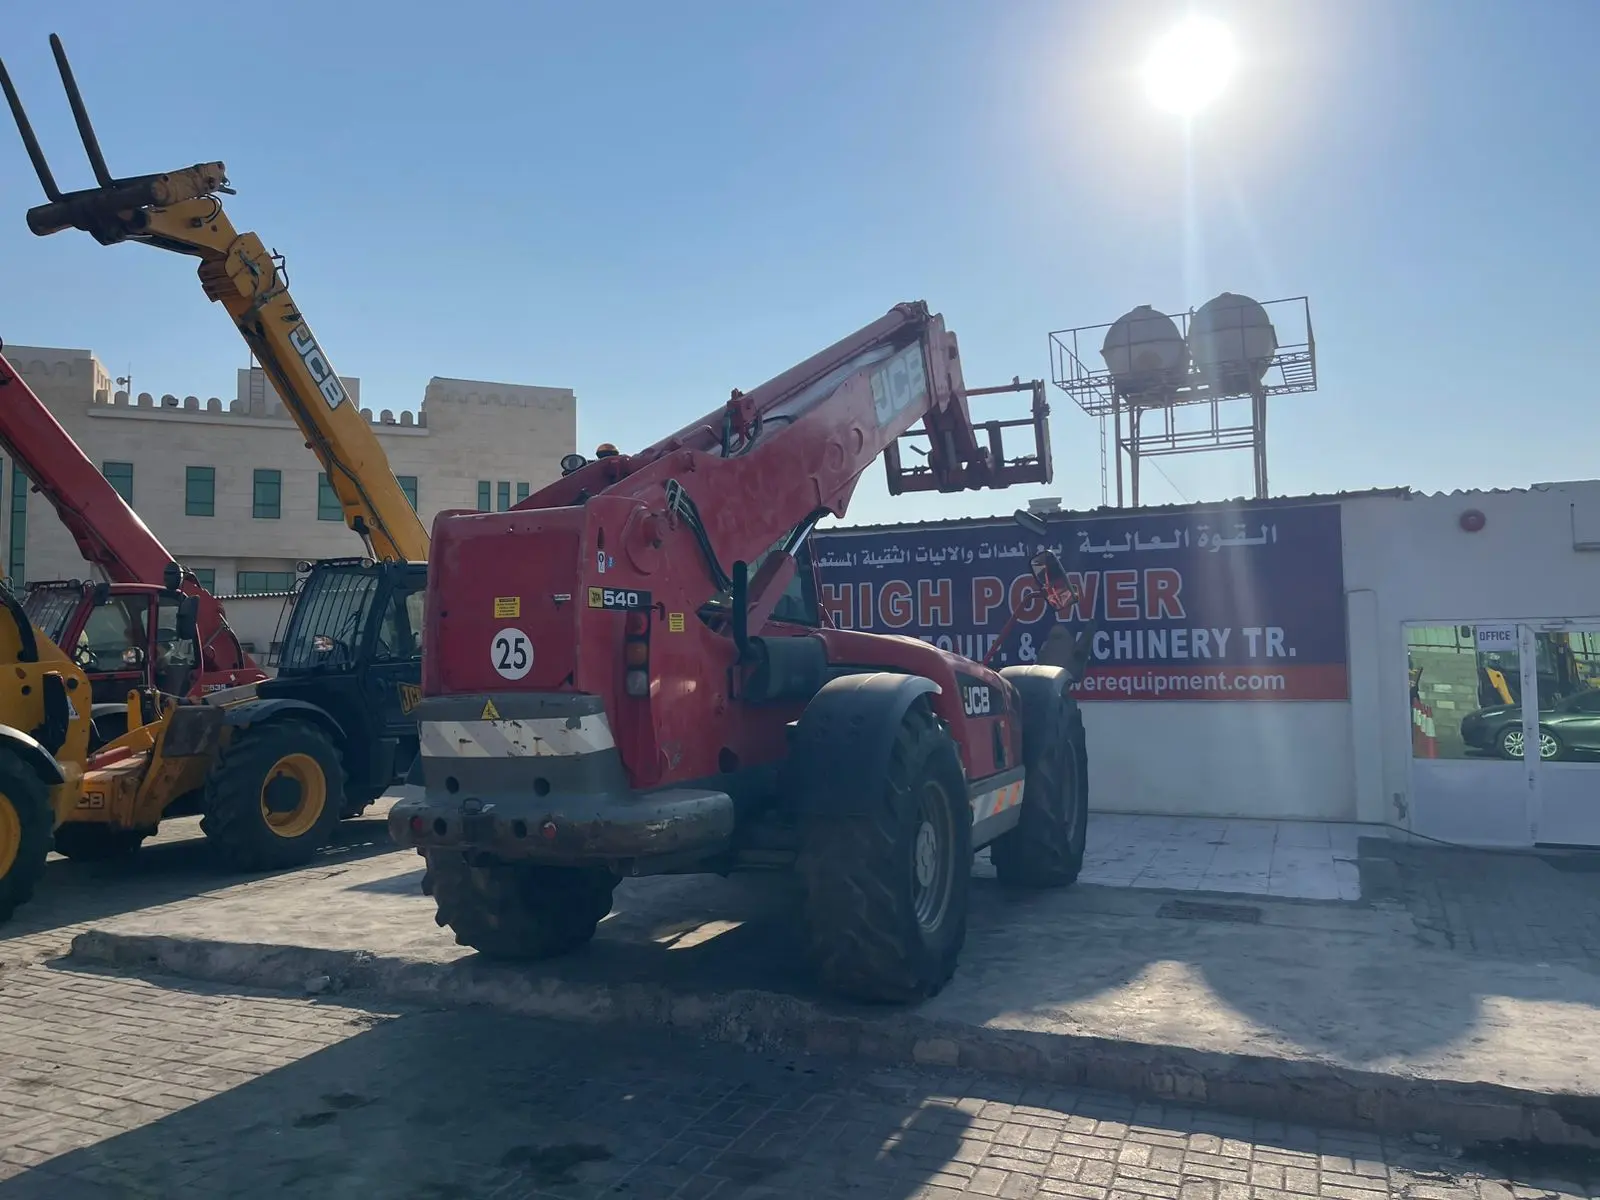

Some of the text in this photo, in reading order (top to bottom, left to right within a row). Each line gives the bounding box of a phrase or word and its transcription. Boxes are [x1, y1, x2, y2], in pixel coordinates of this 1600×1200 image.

[289, 325, 345, 410] JCB
[872, 346, 926, 426] JCB
[862, 544, 911, 569] الثقيلة
[978, 541, 1030, 559] المعدات
[1079, 523, 1277, 559] القوة العالية
[603, 590, 638, 607] 540
[822, 567, 1187, 629] HIGH POWER
[1018, 632, 1037, 662] &
[1042, 627, 1232, 661] CHINERY
[1243, 626, 1297, 658] TR.
[1479, 630, 1511, 641] OFFICE
[495, 637, 527, 670] 25
[964, 685, 990, 716] JCB
[77, 791, 104, 809] CB
